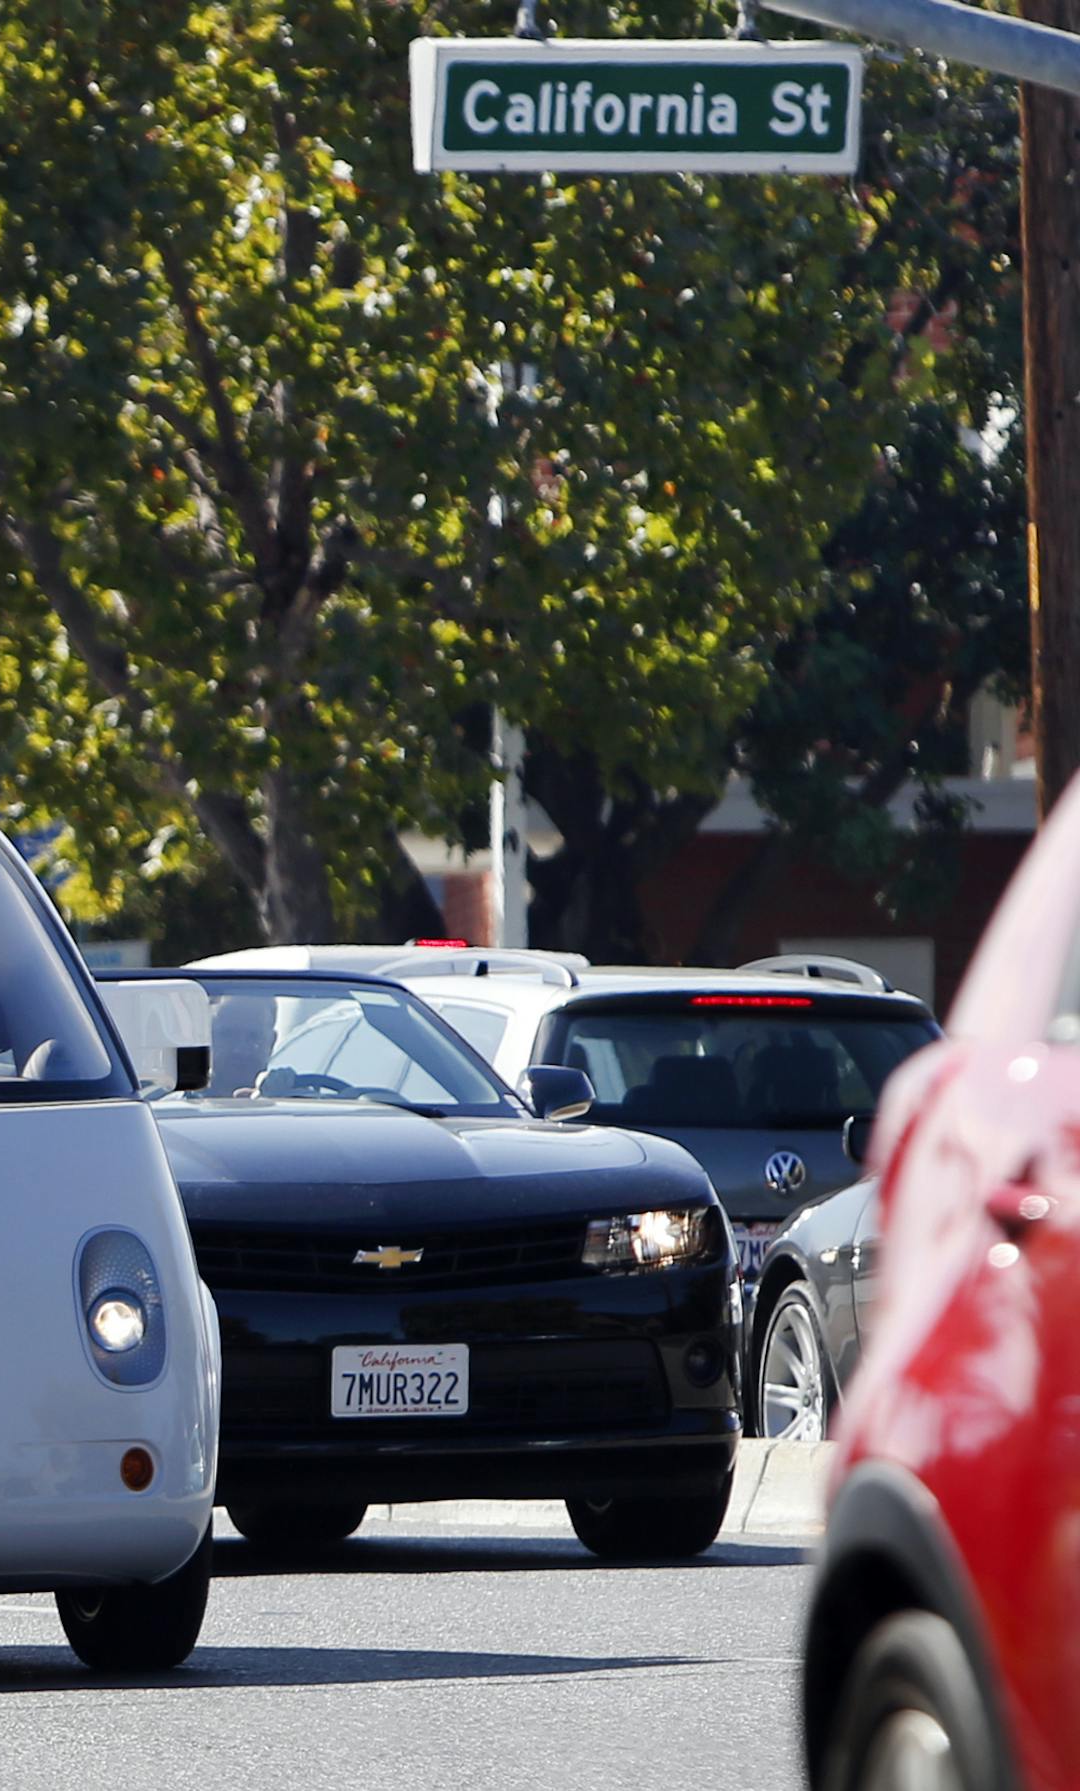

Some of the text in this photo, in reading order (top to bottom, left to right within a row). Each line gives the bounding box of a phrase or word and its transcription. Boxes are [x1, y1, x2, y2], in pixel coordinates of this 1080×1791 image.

[463, 79, 831, 136] California St
[360, 1350, 442, 1371] California
[341, 1371, 459, 1407] 7MUR322
